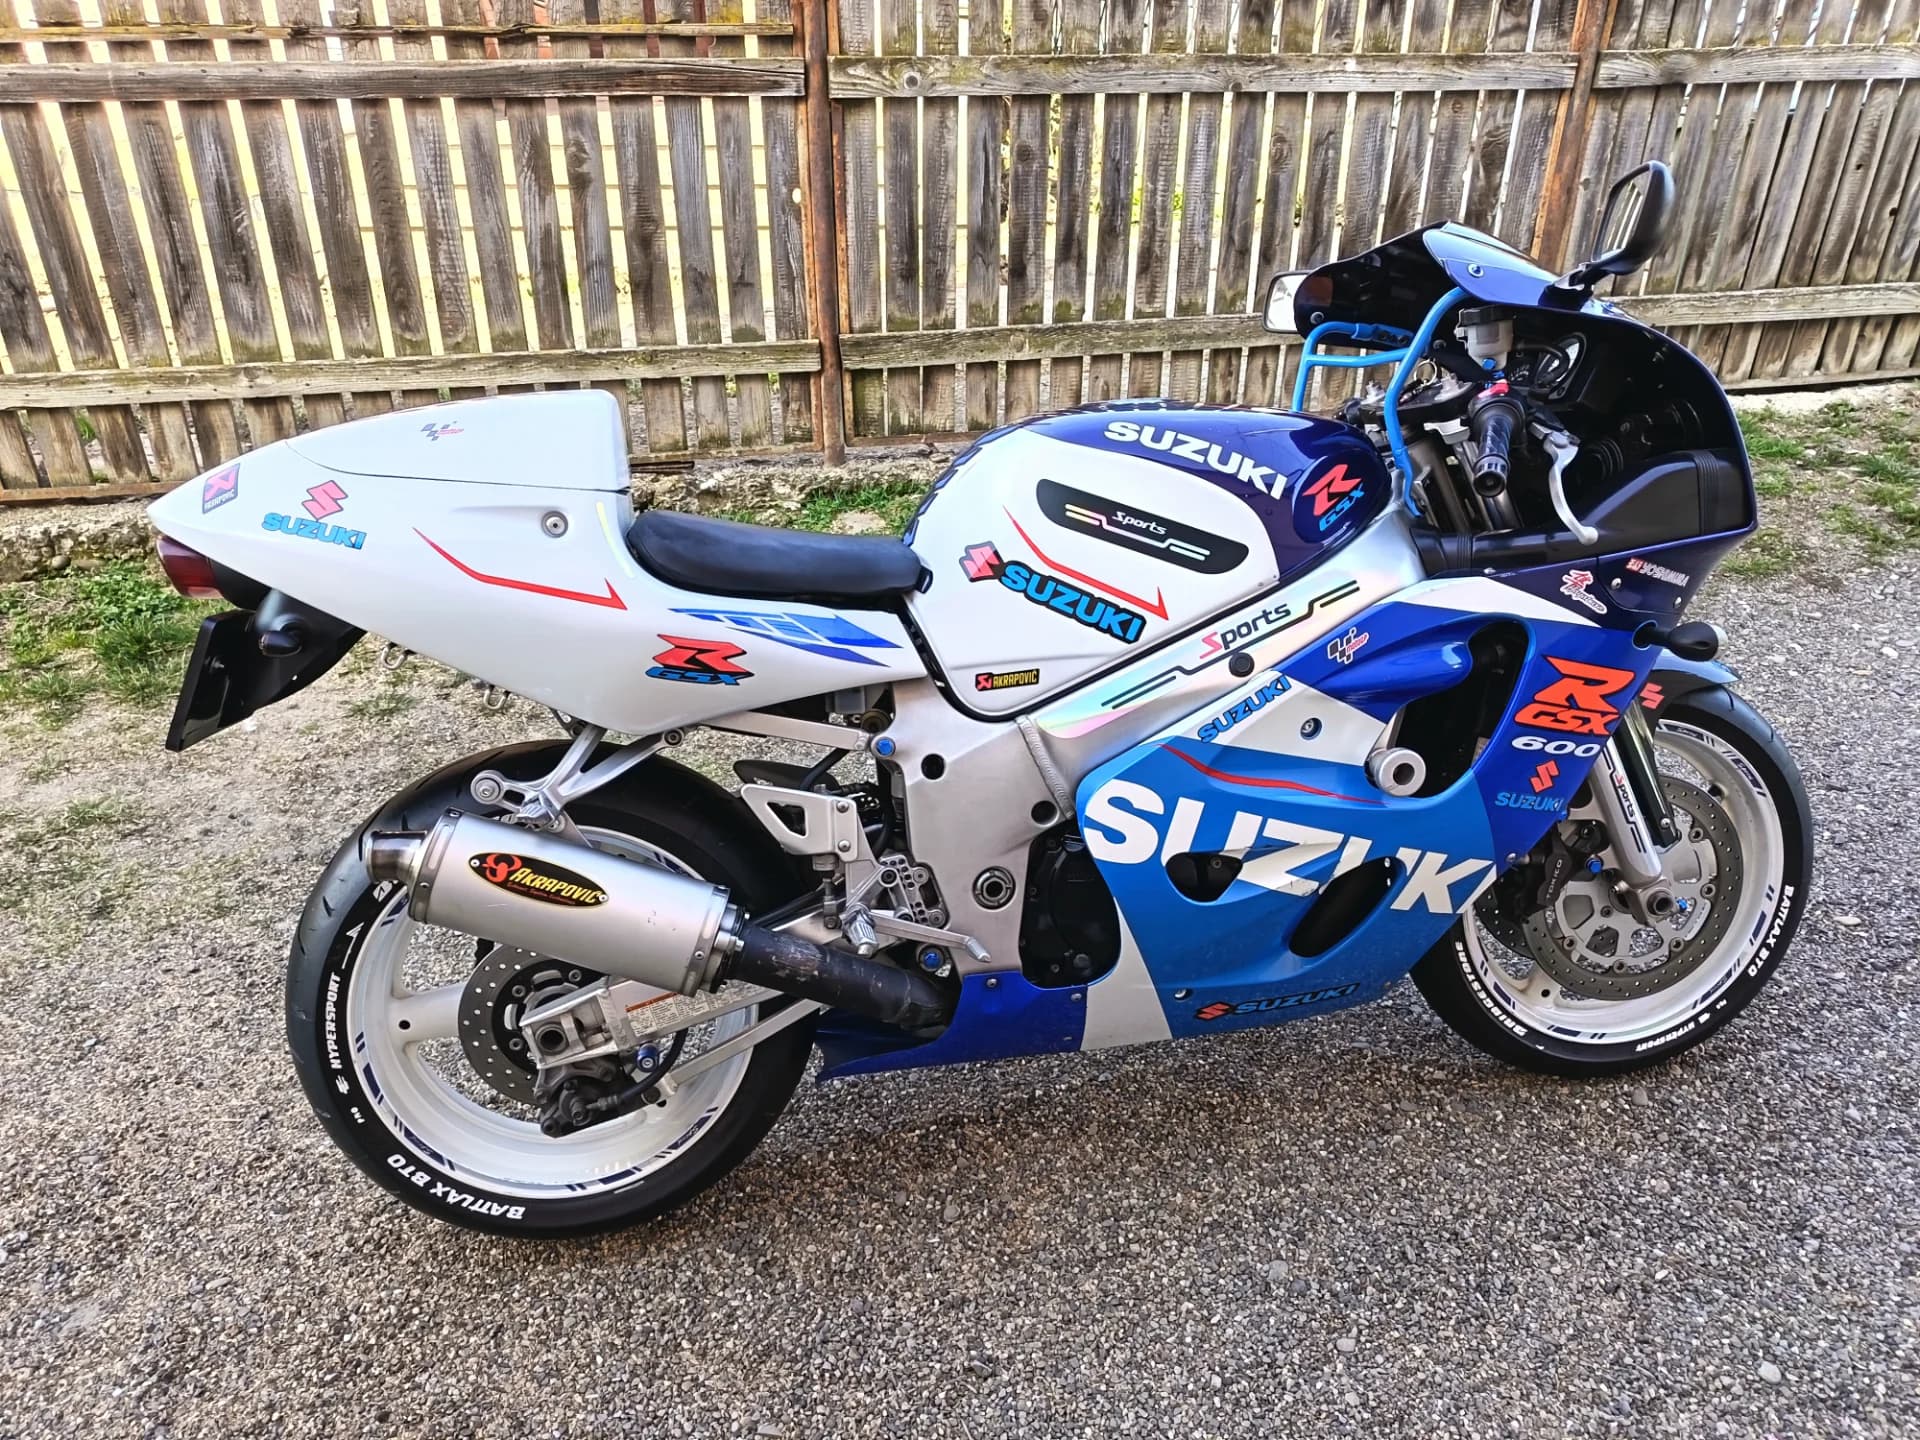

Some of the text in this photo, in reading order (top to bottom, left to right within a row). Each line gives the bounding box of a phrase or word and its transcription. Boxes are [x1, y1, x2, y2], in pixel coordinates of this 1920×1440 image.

[1104, 421, 1289, 500] SUZUKI
[1112, 511, 1167, 535] Sports
[1319, 483, 1365, 532] GSX
[262, 512, 367, 550] SUZUKI
[1001, 565, 1143, 643] SUZUKI
[1199, 602, 1291, 659] Sports
[645, 666, 740, 685] GSX
[1533, 655, 1636, 714] R
[1197, 674, 1292, 743] SUZUKI
[1514, 703, 1620, 736] GSX
[1511, 736, 1600, 757] 600
[1495, 792, 1564, 812] SUZUKI
[1614, 774, 1636, 818] Sports
[1233, 983, 1360, 1015] SUZUKI
[1455, 941, 1528, 1036] BRIDGESTONE
[325, 971, 342, 1069] HYPERSPORT
[429, 1181, 526, 1219] BATTLAX
